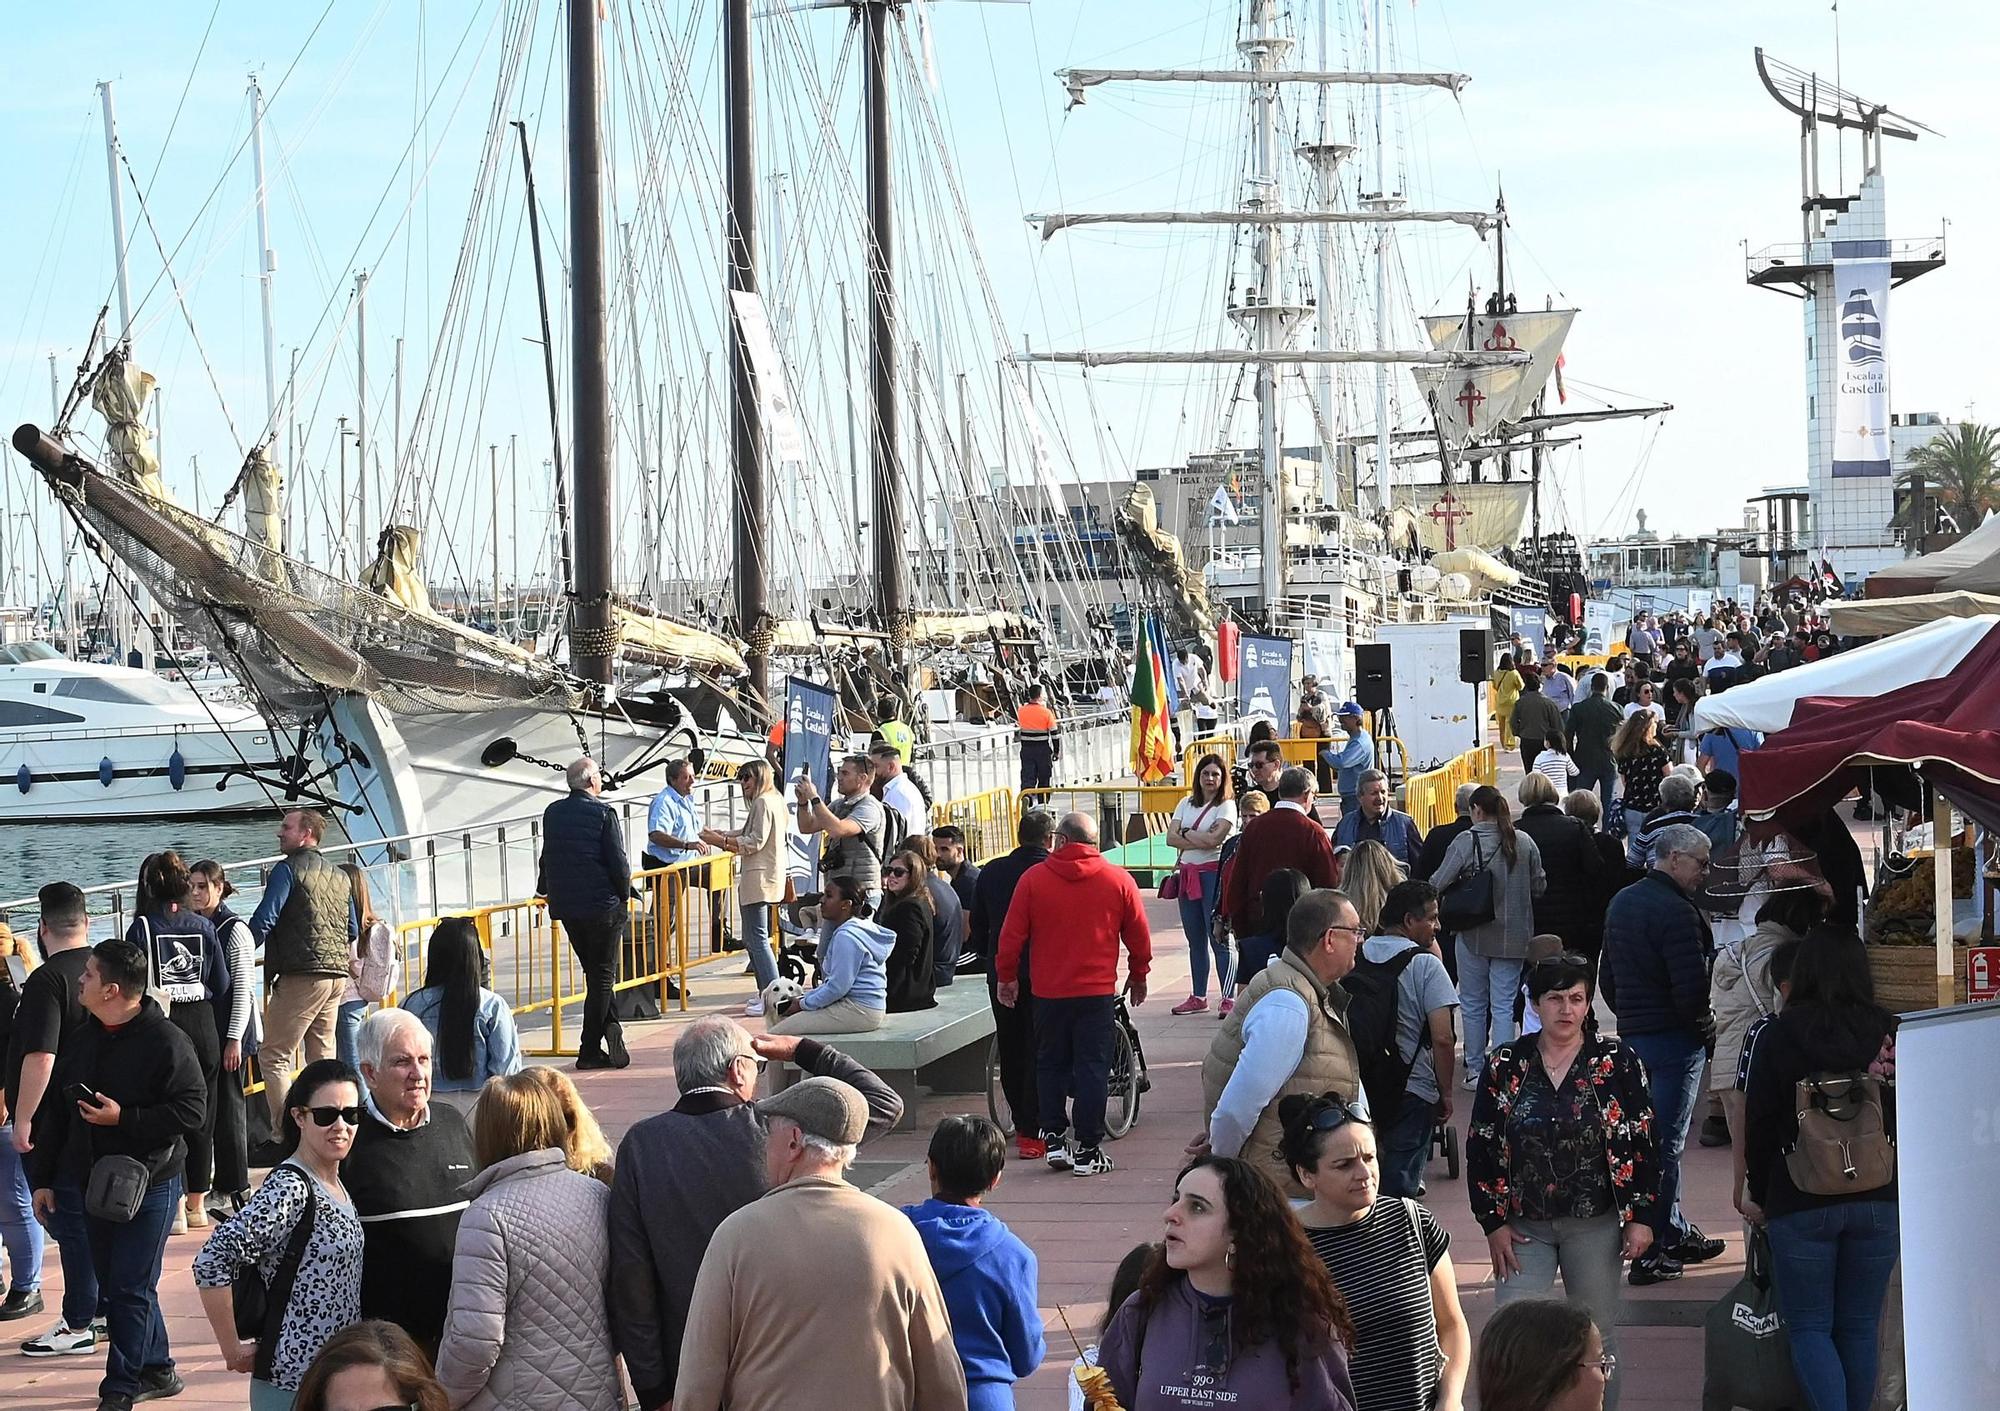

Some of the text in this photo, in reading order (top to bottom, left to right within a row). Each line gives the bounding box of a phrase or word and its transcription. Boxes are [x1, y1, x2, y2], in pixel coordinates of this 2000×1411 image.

[1160, 1386, 1238, 1402] UPPER EAST SIDE
